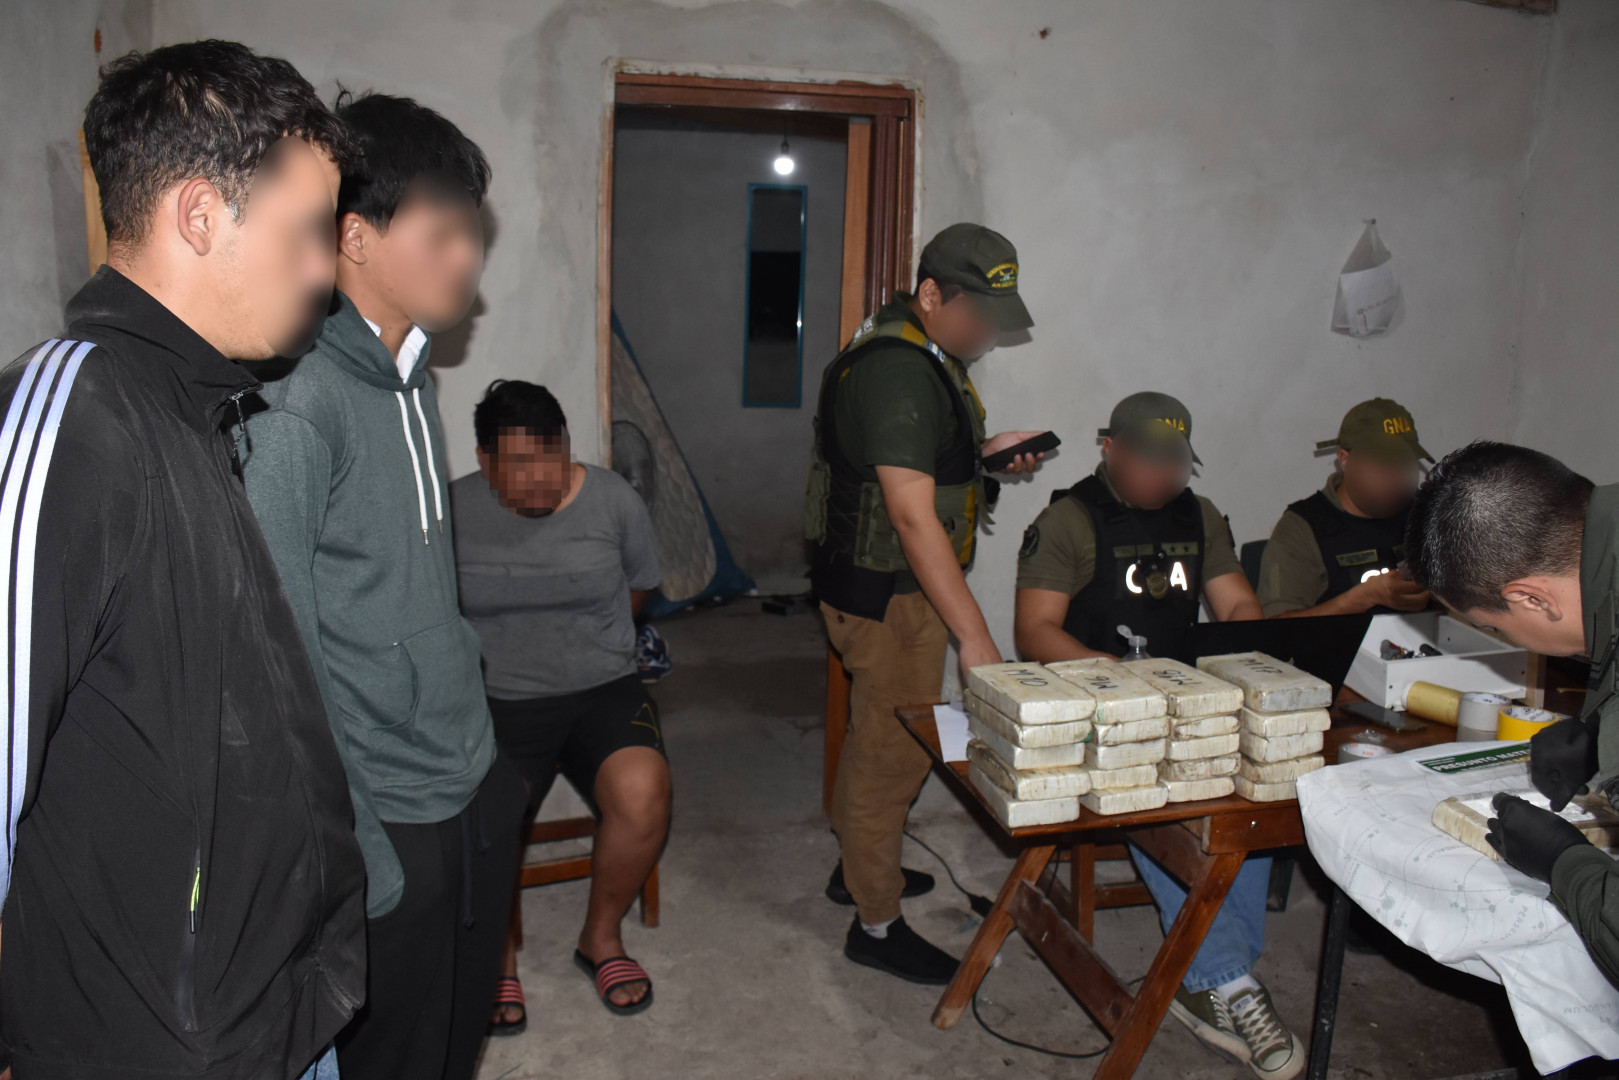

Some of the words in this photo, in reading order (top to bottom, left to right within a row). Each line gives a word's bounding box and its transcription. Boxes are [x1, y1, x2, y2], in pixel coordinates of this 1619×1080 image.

[1155, 418, 1186, 432] NA
[1384, 417, 1412, 434] GNA
[1432, 756, 1497, 771] PRESUNTO
[1497, 749, 1531, 760] MATE
